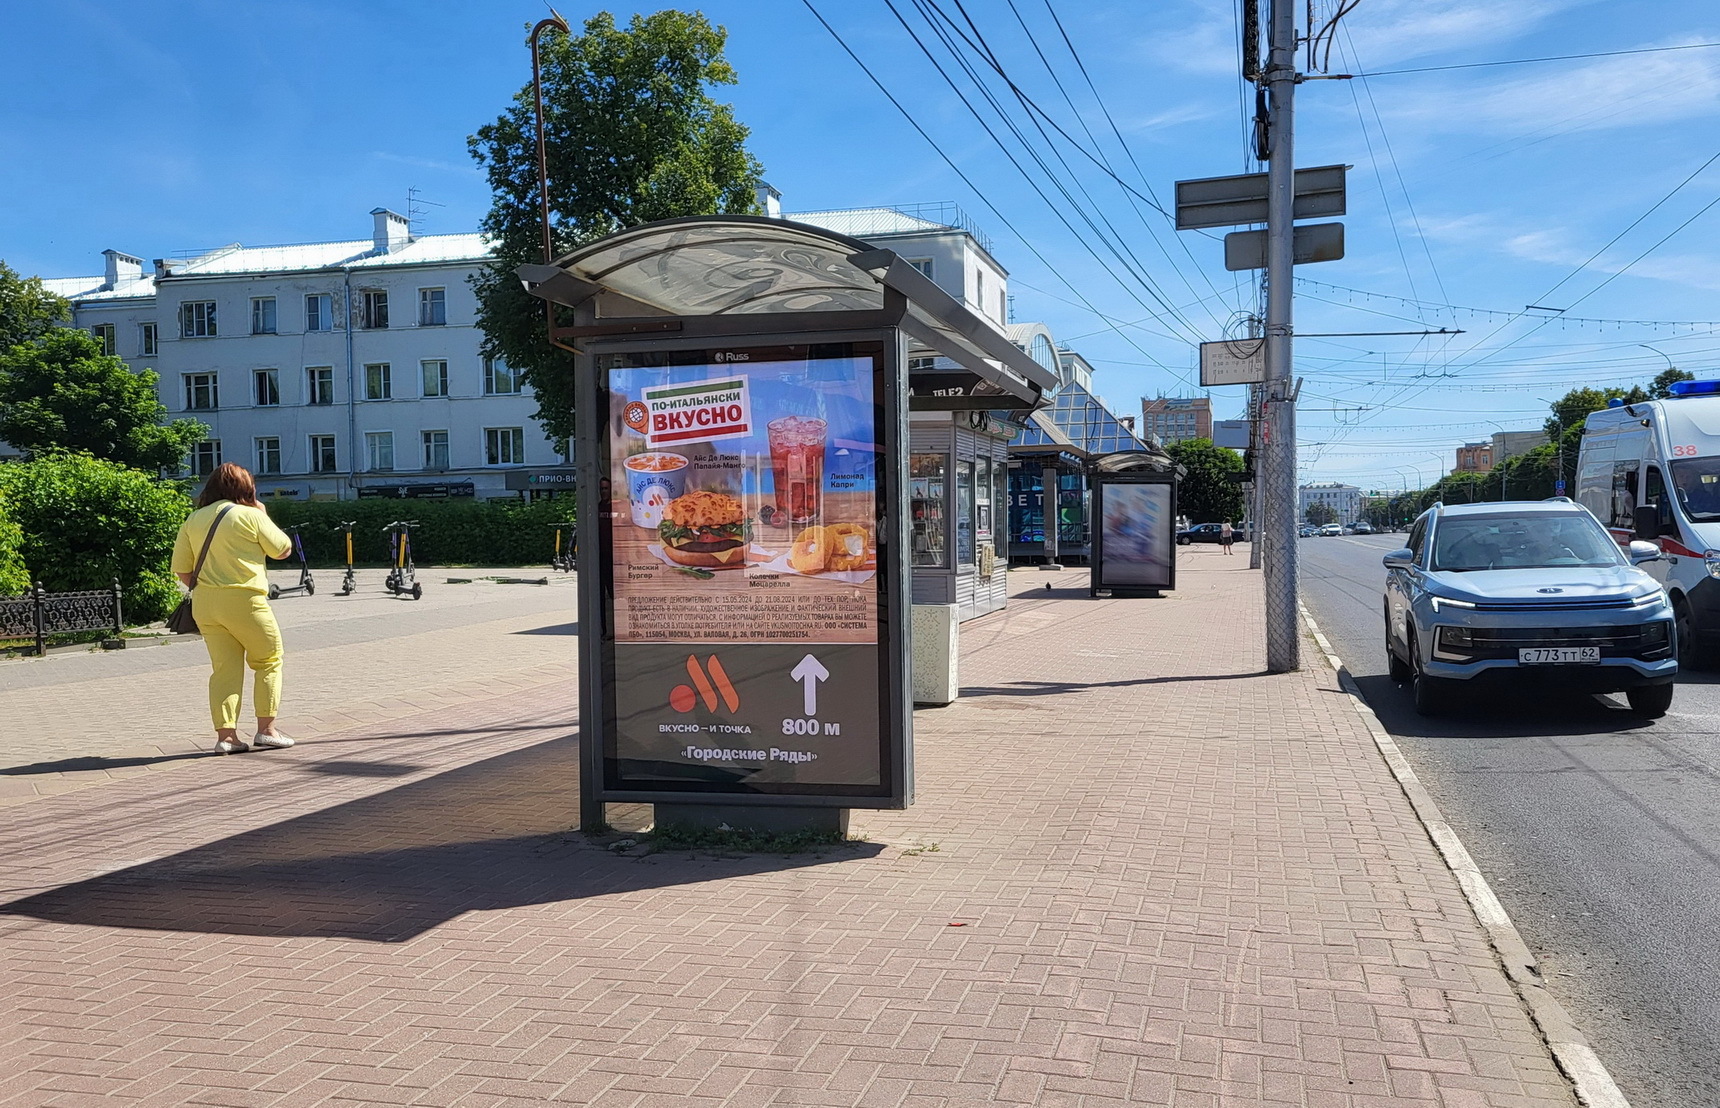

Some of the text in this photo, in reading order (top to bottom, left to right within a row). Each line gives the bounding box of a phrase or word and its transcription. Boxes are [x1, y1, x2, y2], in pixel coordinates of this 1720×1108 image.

[726, 352, 749, 361] Russ
[933, 387, 963, 396] TELE2
[652, 392, 740, 411] ПО-ИТАЛЬЯНСКИ
[653, 404, 742, 431] ВКУСНО
[1673, 445, 1697, 456] 38
[636, 480, 646, 494] АЙС
[658, 478, 676, 494] ЛЮКС
[1007, 494, 1062, 506] ВЕТ
[670, 596, 712, 604] ДЕЙСТВИТЕЛЬНО
[1582, 648, 1594, 657] 62
[659, 724, 699, 733] ВКУСНО
[719, 725, 751, 734] ТОЧКА
[782, 719, 840, 735] 800 м
[681, 746, 818, 764] «Городские Ряды»
